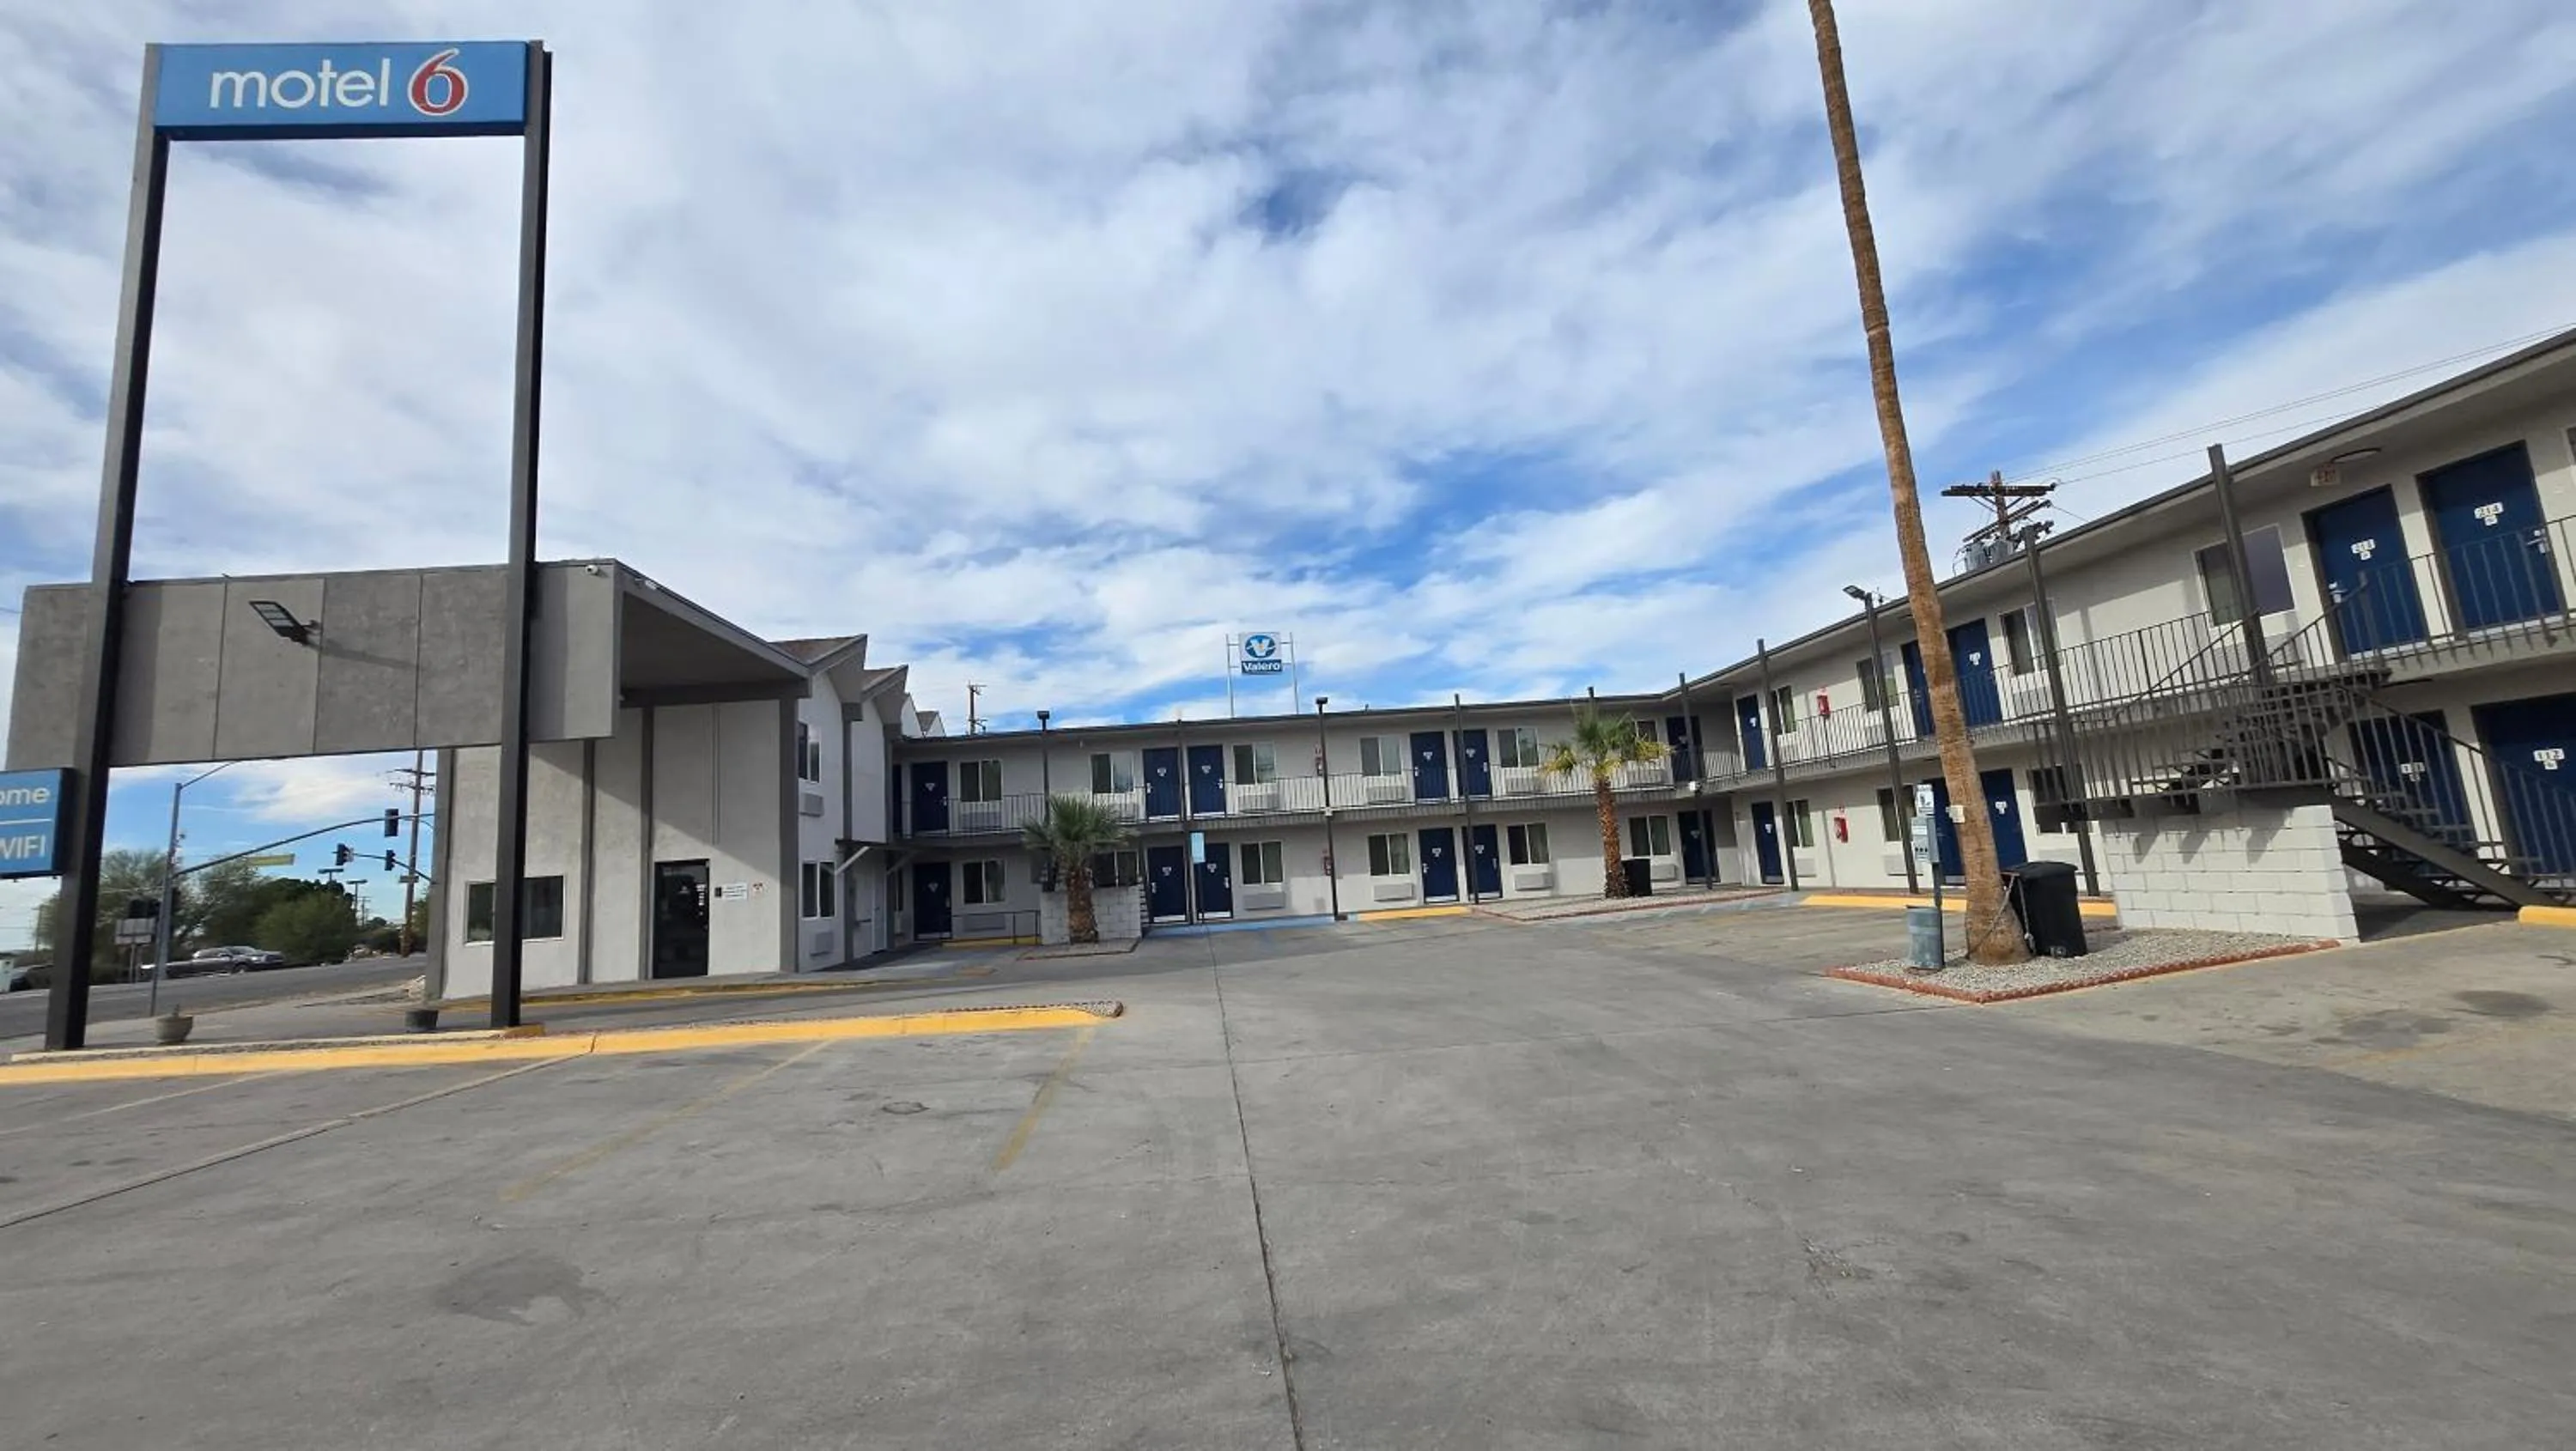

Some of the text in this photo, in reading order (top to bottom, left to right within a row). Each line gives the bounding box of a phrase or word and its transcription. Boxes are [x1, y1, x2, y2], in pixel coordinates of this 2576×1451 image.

[210, 48, 469, 116] motel 6
[1242, 662, 1281, 672] Valero
